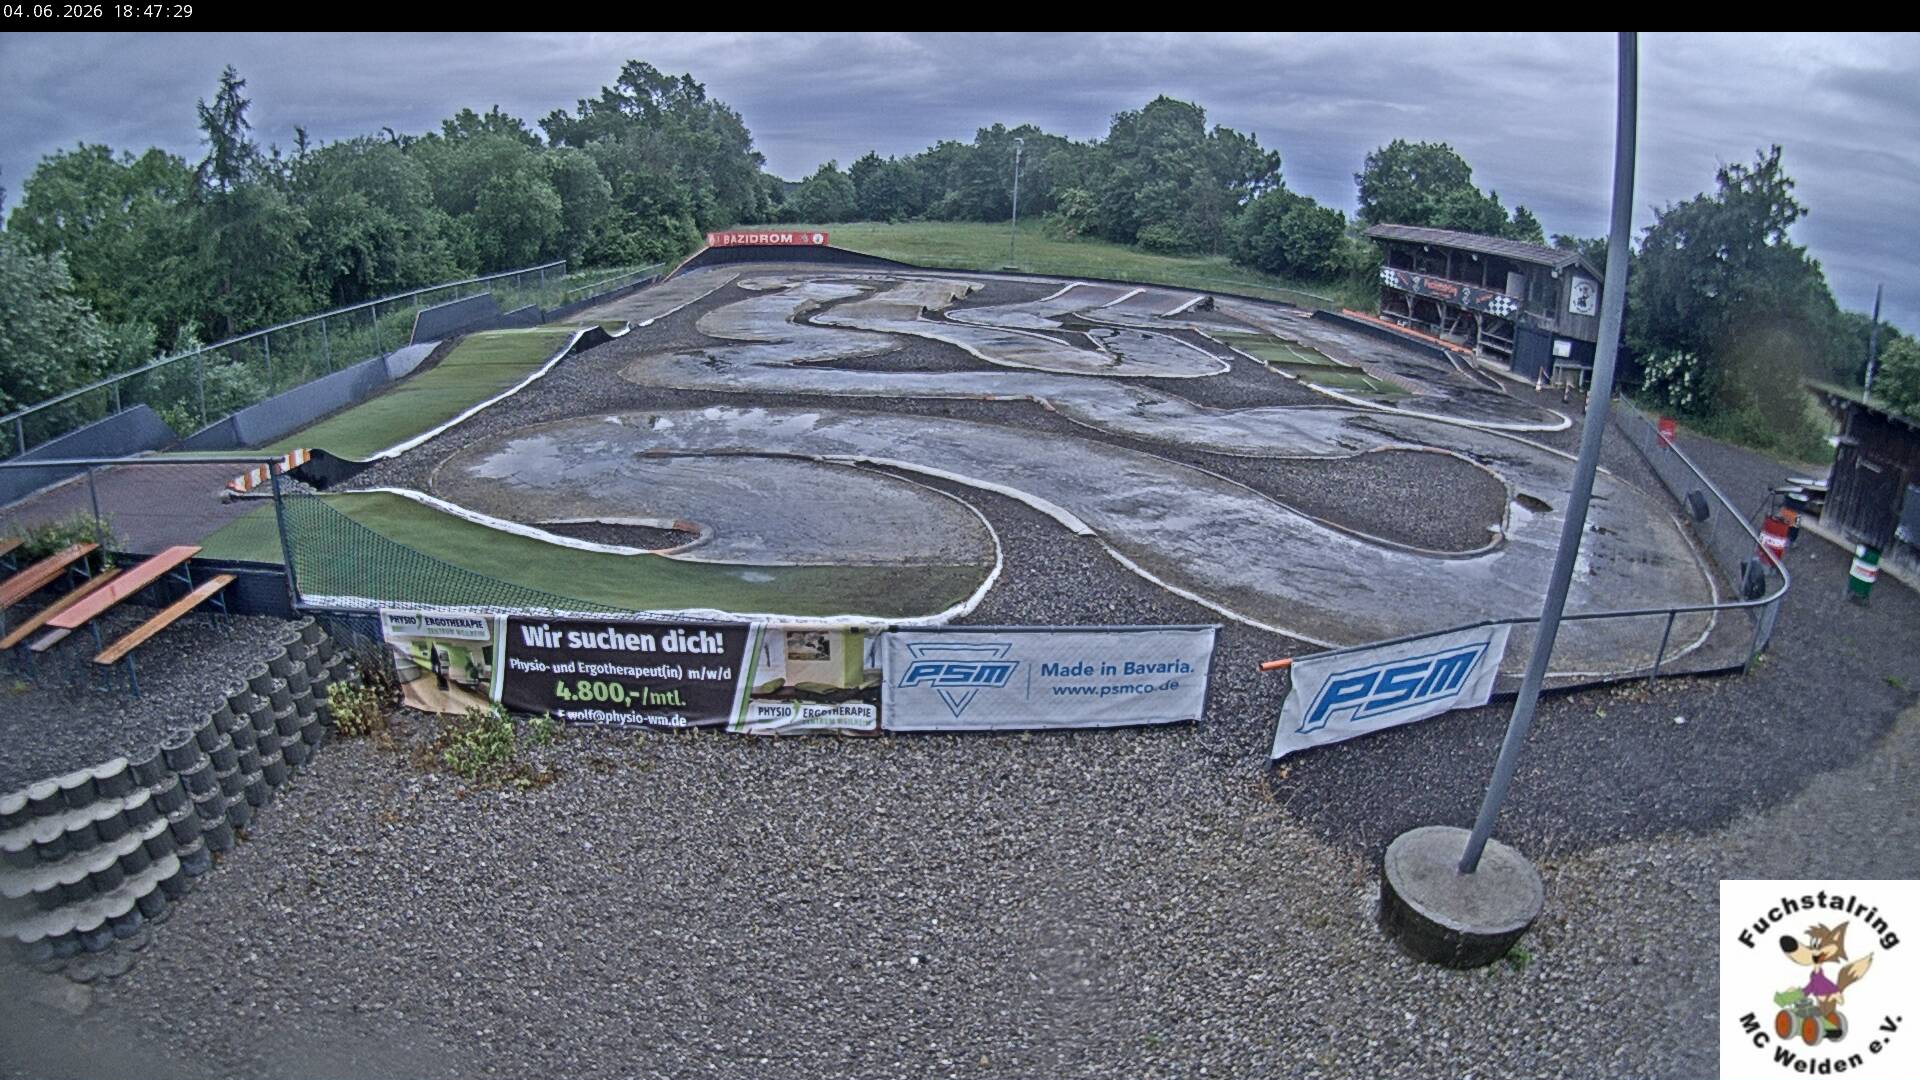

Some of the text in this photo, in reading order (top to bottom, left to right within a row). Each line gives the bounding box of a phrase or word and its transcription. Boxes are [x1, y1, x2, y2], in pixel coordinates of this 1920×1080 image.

[723, 233, 793, 244] BAZIDROM
[388, 614, 484, 629] PHYSIO ERGOTHERAPIE
[521, 624, 725, 654] Wir suchen dich!
[509, 656, 732, 680] Physio- und Ergotherapeut(in) m/w/d
[903, 662, 1014, 684] PSM
[1041, 658, 1195, 677] Made in Bavaria.
[1052, 679, 1180, 698] www.psmco.de
[1304, 647, 1482, 727] PSM
[758, 705, 872, 718] PHYSIO ERGOTHERAPIE
